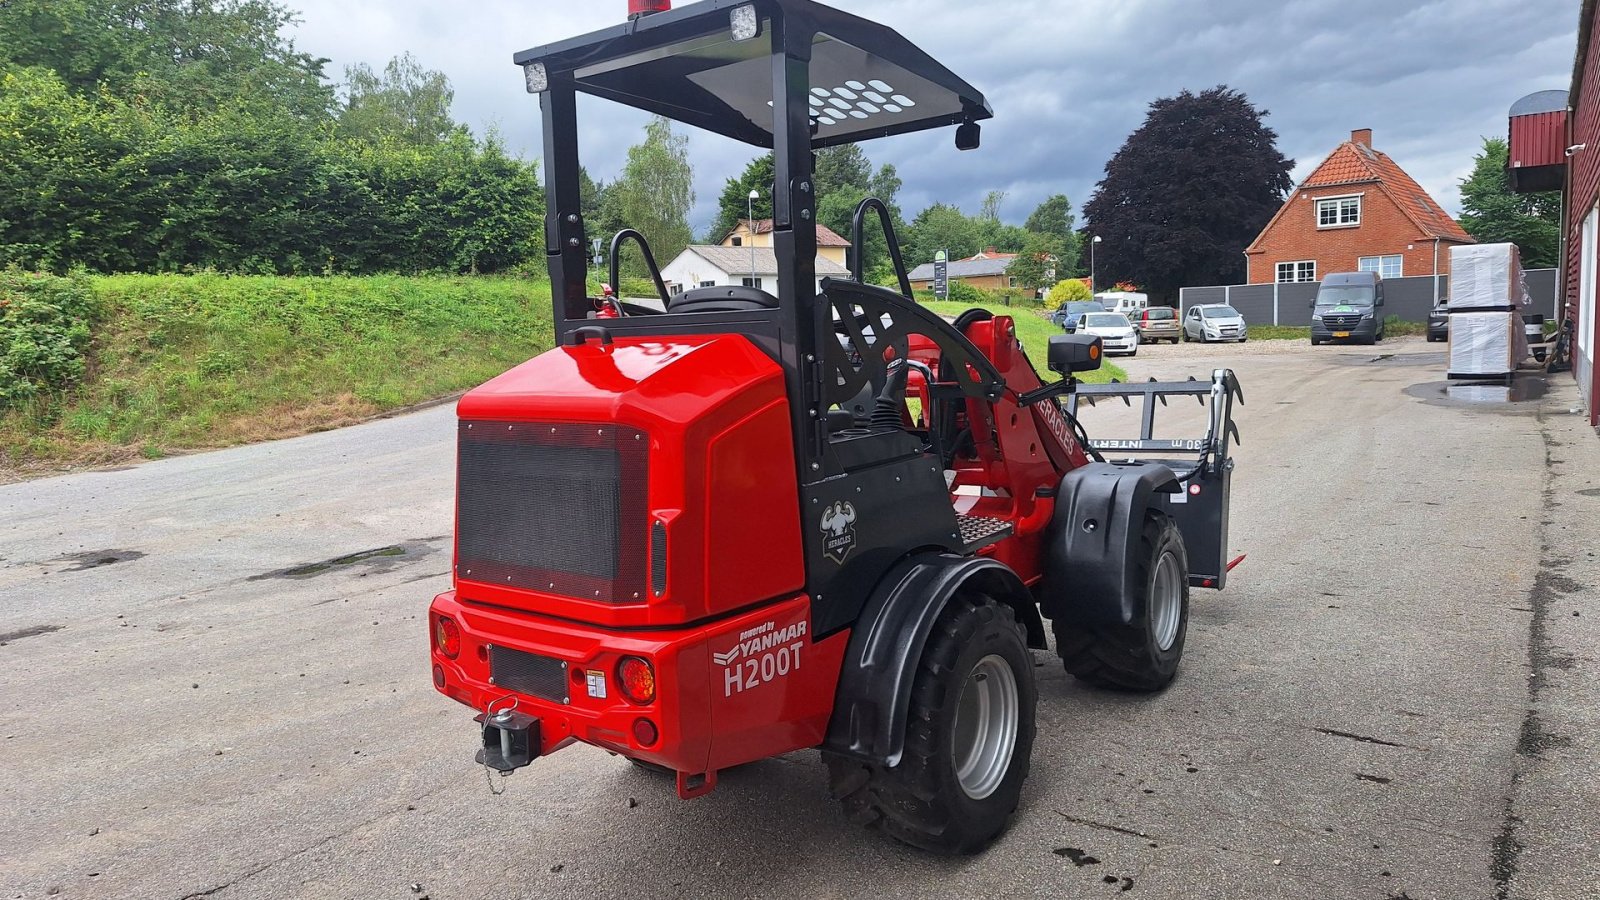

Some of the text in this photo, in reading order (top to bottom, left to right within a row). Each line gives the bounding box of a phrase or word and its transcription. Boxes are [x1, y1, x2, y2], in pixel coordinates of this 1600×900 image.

[1037, 399, 1075, 455] ERACLES
[1088, 440, 1142, 449] INTERT
[828, 534, 851, 549] HERACLES
[740, 621, 775, 641] powered by
[740, 620, 807, 658] YANMAR
[724, 641, 804, 697] H200T
